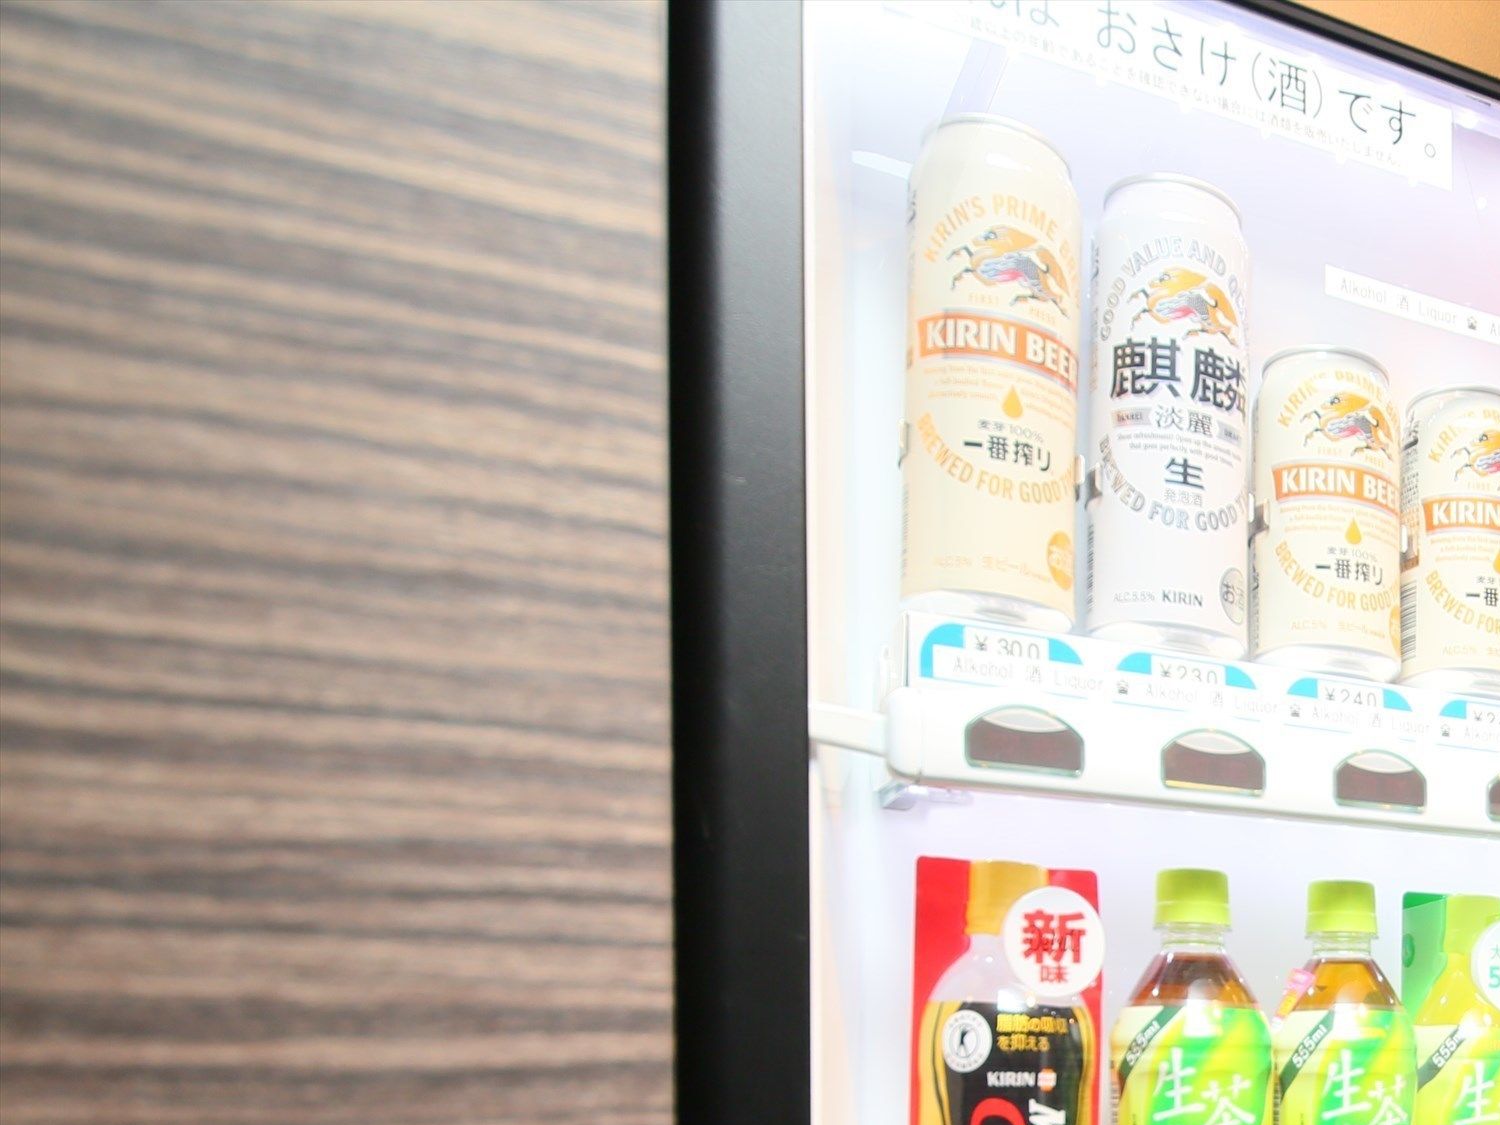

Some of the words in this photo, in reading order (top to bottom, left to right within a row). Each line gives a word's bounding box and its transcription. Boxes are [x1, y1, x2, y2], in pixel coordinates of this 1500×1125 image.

[992, 195, 1057, 240] PRIME
[1100, 277, 1126, 342] GOOD
[1122, 236, 1183, 276] VALUE
[1188, 239, 1227, 276] AND
[926, 318, 1016, 355] KIRIN
[1110, 334, 1246, 414] 麒麟
[1155, 405, 1213, 438] 淡麗
[916, 412, 973, 484] BREWED
[977, 469, 1014, 500] FOR
[1020, 478, 1062, 504] GOOD
[962, 434, 1051, 473] 一番搾り
[1164, 457, 1206, 491] 生
[1282, 467, 1355, 495] KIRIN
[1147, 500, 1190, 530] FOR
[1195, 506, 1238, 533] GOOD
[1164, 489, 1202, 507] 発泡酒
[1275, 540, 1324, 598] BREWED
[1327, 586, 1356, 610] FOR
[1360, 590, 1392, 612] GOOD
[1315, 558, 1384, 585] 一番搾り
[1161, 589, 1203, 607] KIRIN
[1426, 569, 1474, 625] BREWED
[1020, 909, 1087, 965] 新
[1039, 964, 1069, 983] 味
[1292, 1023, 1328, 1069] 555ml
[986, 1070, 1037, 1088] KIRIN
